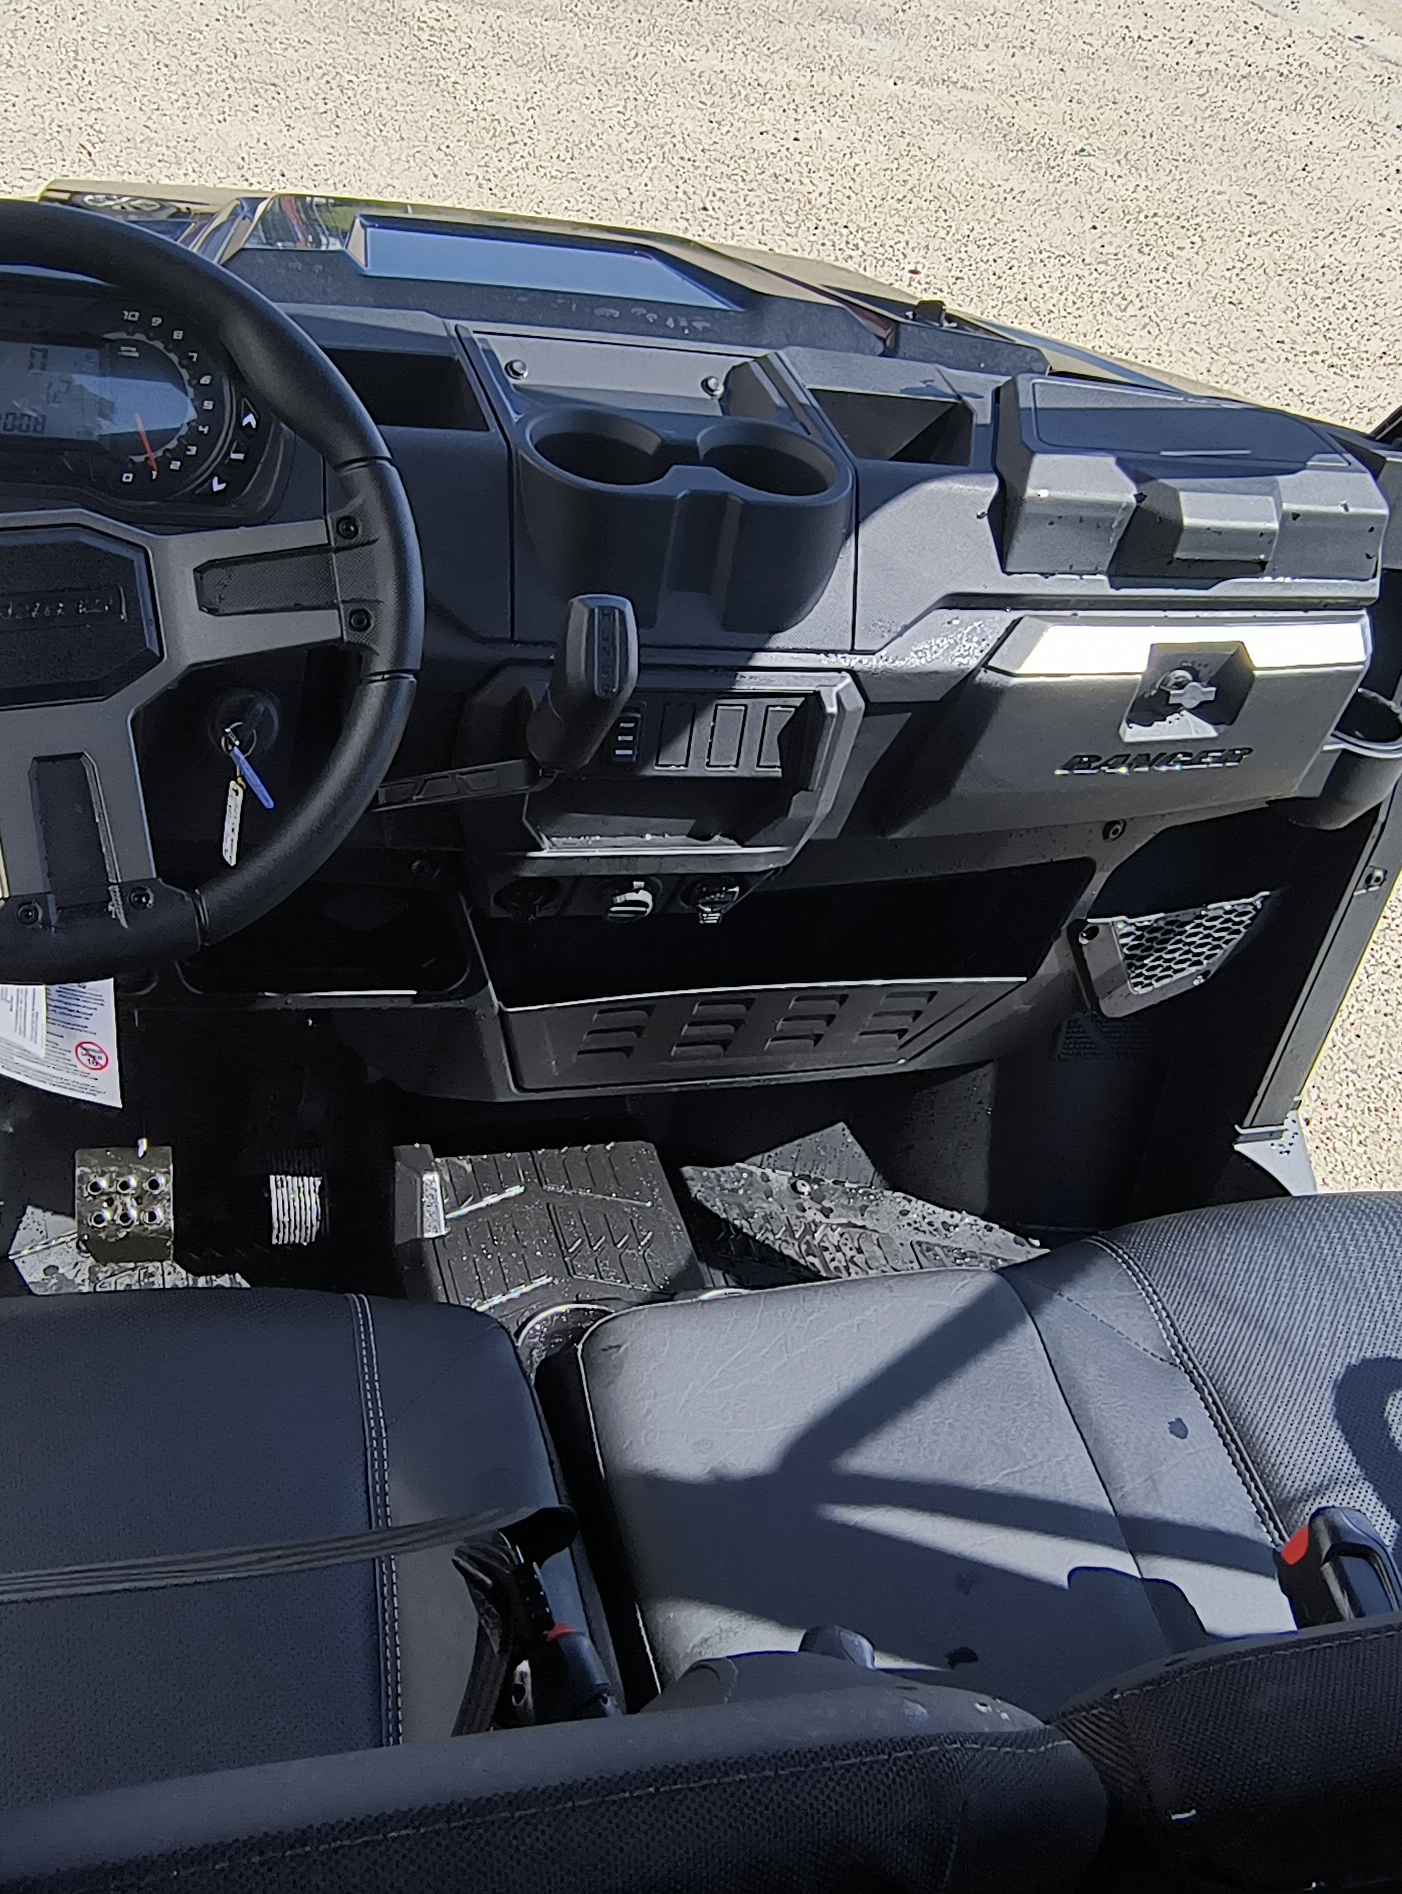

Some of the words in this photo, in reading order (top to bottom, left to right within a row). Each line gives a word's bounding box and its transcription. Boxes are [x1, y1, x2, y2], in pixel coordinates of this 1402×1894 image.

[123, 310, 140, 322] 10
[151, 316, 162, 327] 9
[173, 330, 184, 340] 8
[188, 352, 198, 362] 7
[199, 375, 212, 385] 6
[202, 400, 214, 410] 5
[198, 424, 209, 434] 4
[185, 445, 197, 455] 3
[169, 460, 181, 470] 2
[122, 472, 134, 482] 0
[1053, 747, 1254, 775] RANGER
